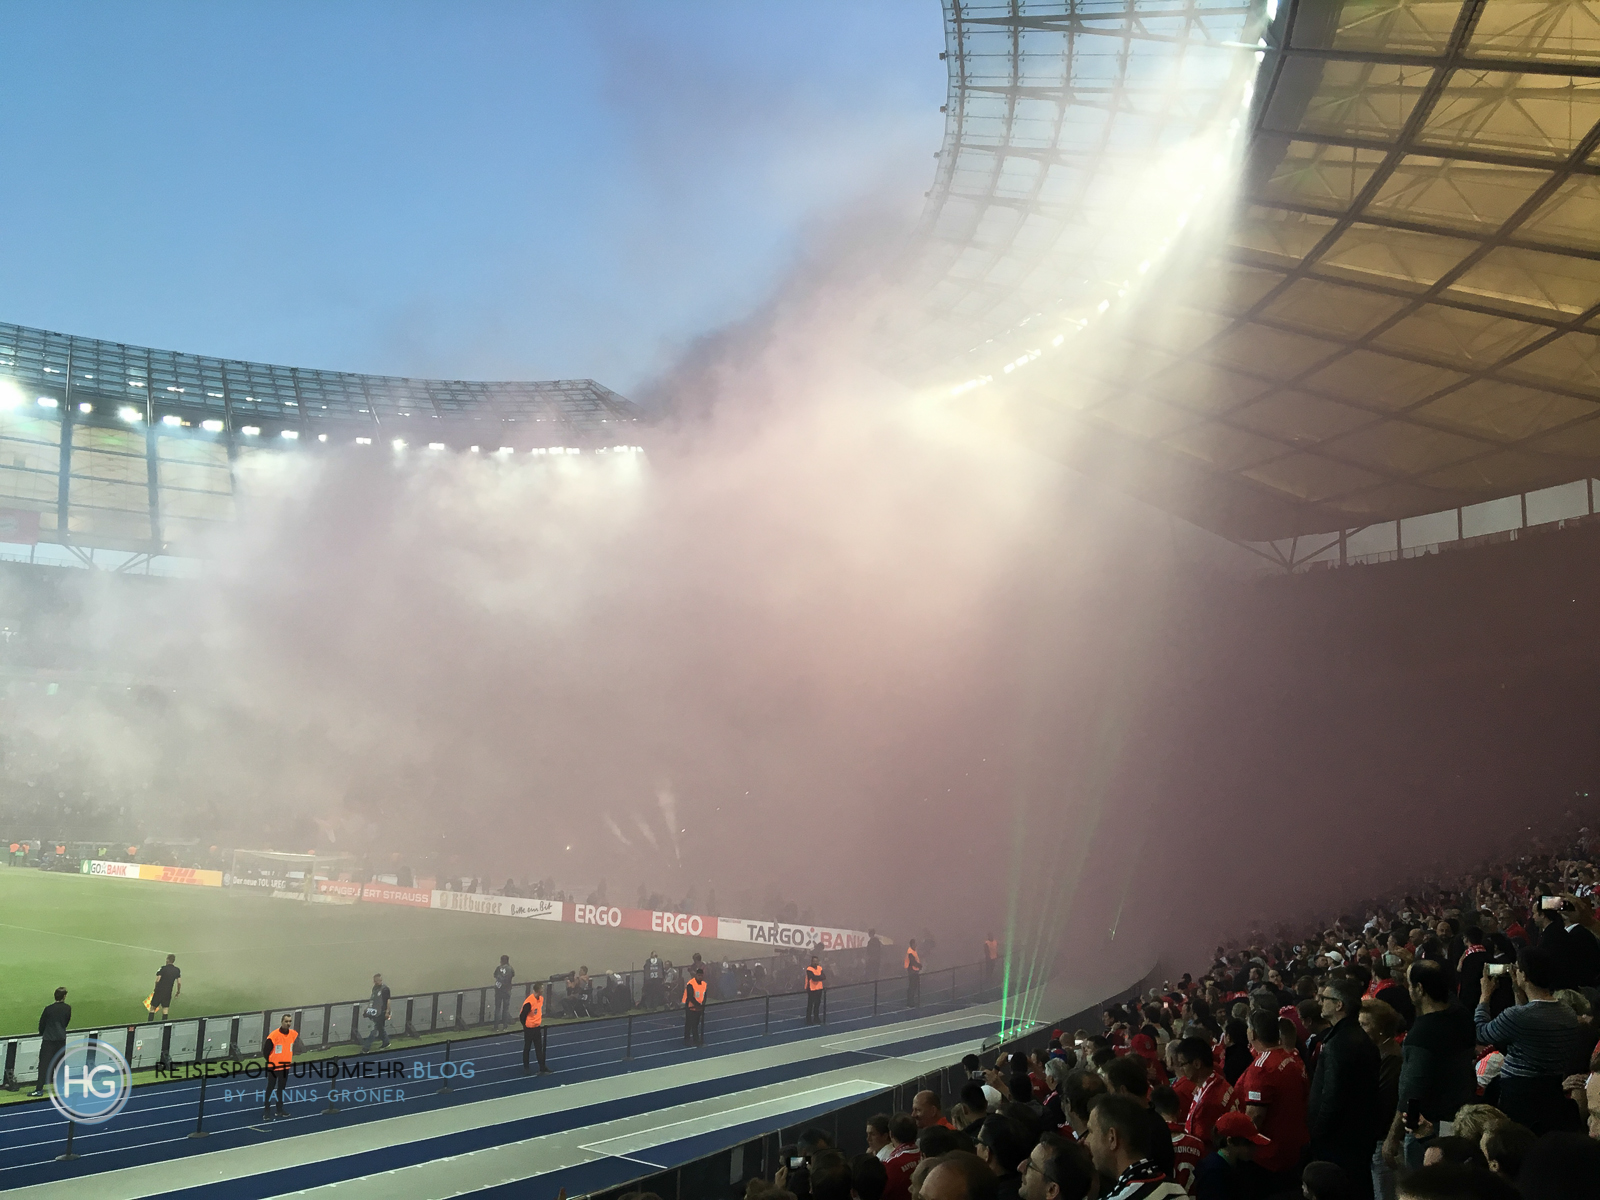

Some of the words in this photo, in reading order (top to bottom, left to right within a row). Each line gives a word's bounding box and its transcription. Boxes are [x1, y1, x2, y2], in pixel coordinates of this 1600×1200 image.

[107, 864, 127, 876] BANK
[161, 866, 197, 884] DHL
[383, 890, 429, 903] STRAUSS
[452, 893, 502, 914] Bitburger
[510, 904, 526, 915] Bitte
[539, 901, 553, 911] Bit
[575, 903, 622, 927] ERGO
[652, 911, 703, 936] ERGO
[820, 931, 865, 949] BANK
